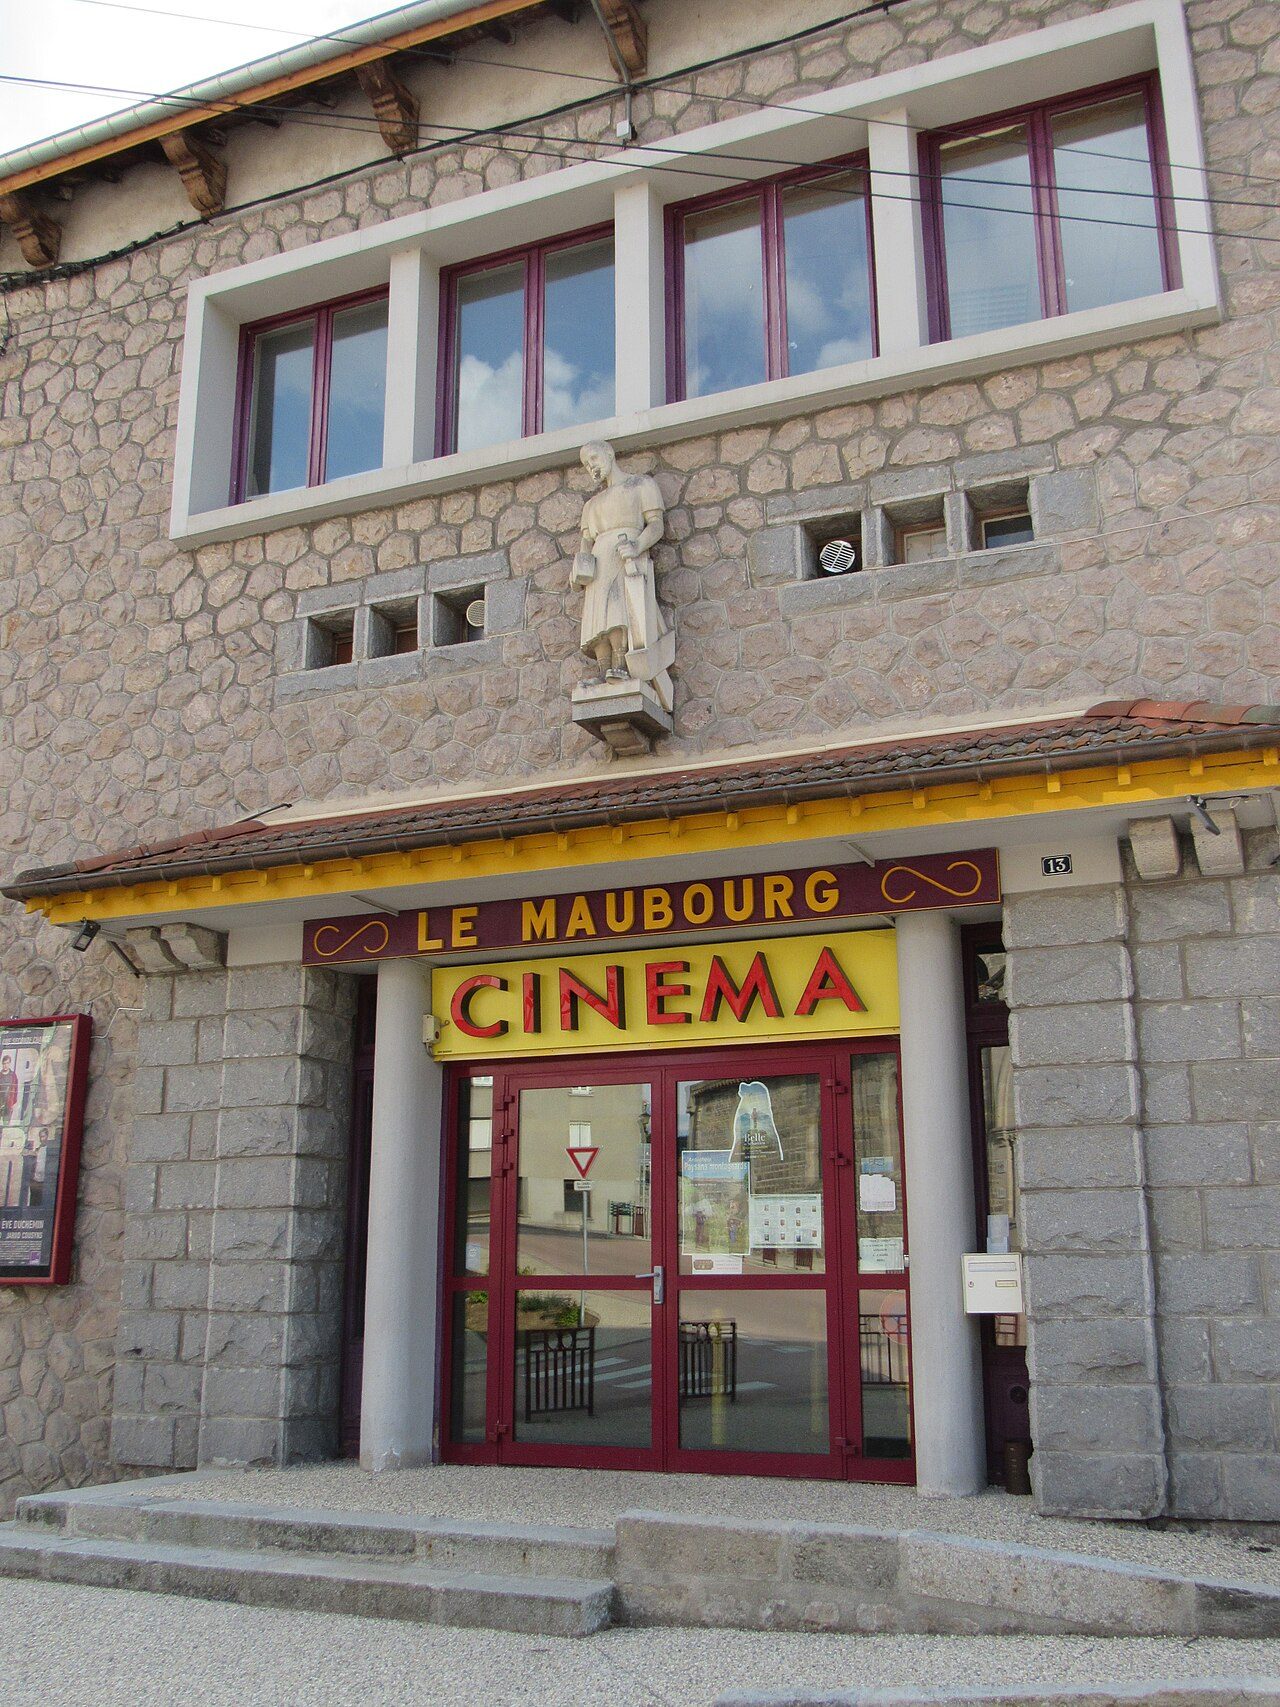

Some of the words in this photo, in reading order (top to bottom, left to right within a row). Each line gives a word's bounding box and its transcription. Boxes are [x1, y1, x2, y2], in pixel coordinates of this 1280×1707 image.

[1047, 858, 1066, 872] 13
[417, 906, 479, 951] LE
[521, 870, 840, 942] MAUBOURG
[450, 946, 869, 1038] CINEMA
